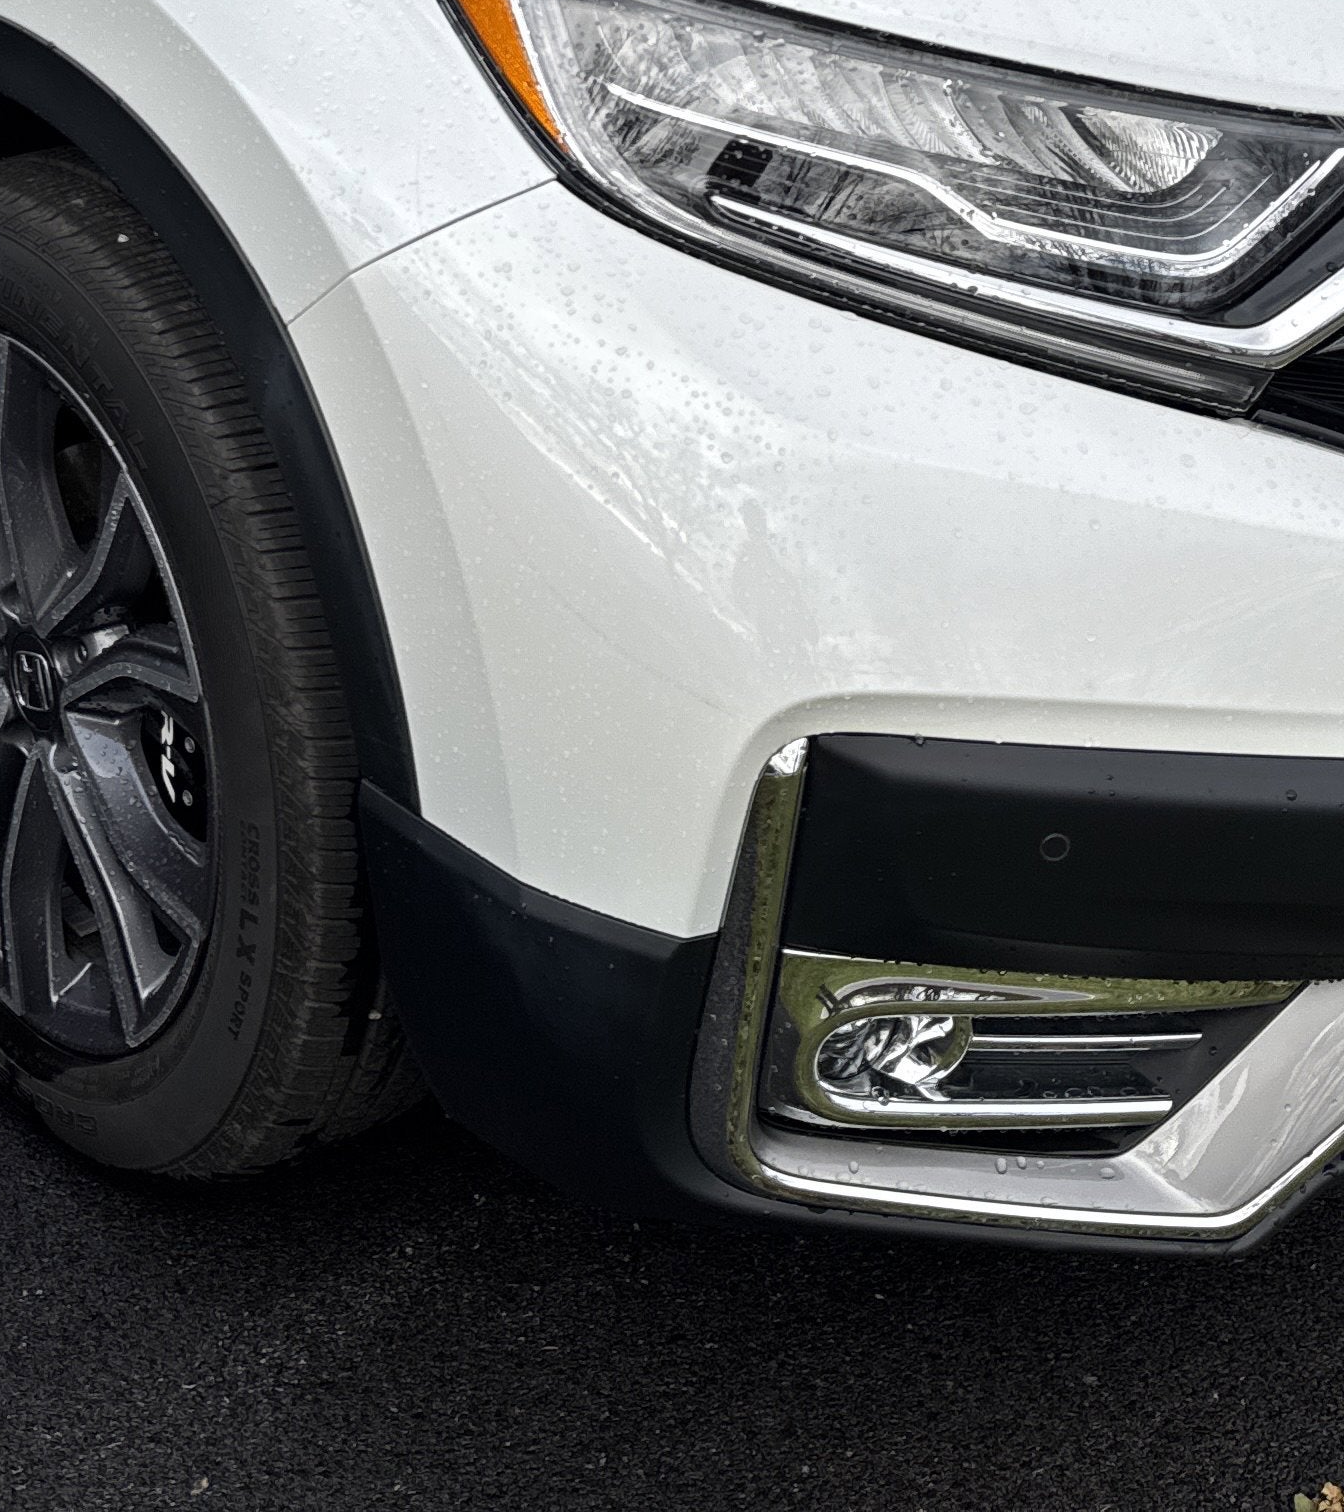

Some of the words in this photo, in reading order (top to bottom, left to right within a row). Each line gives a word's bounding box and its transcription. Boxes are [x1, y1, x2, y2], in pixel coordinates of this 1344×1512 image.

[160, 709, 176, 804] R-V
[246, 821, 261, 906] CROSS
[227, 969, 253, 1042] SPORT
